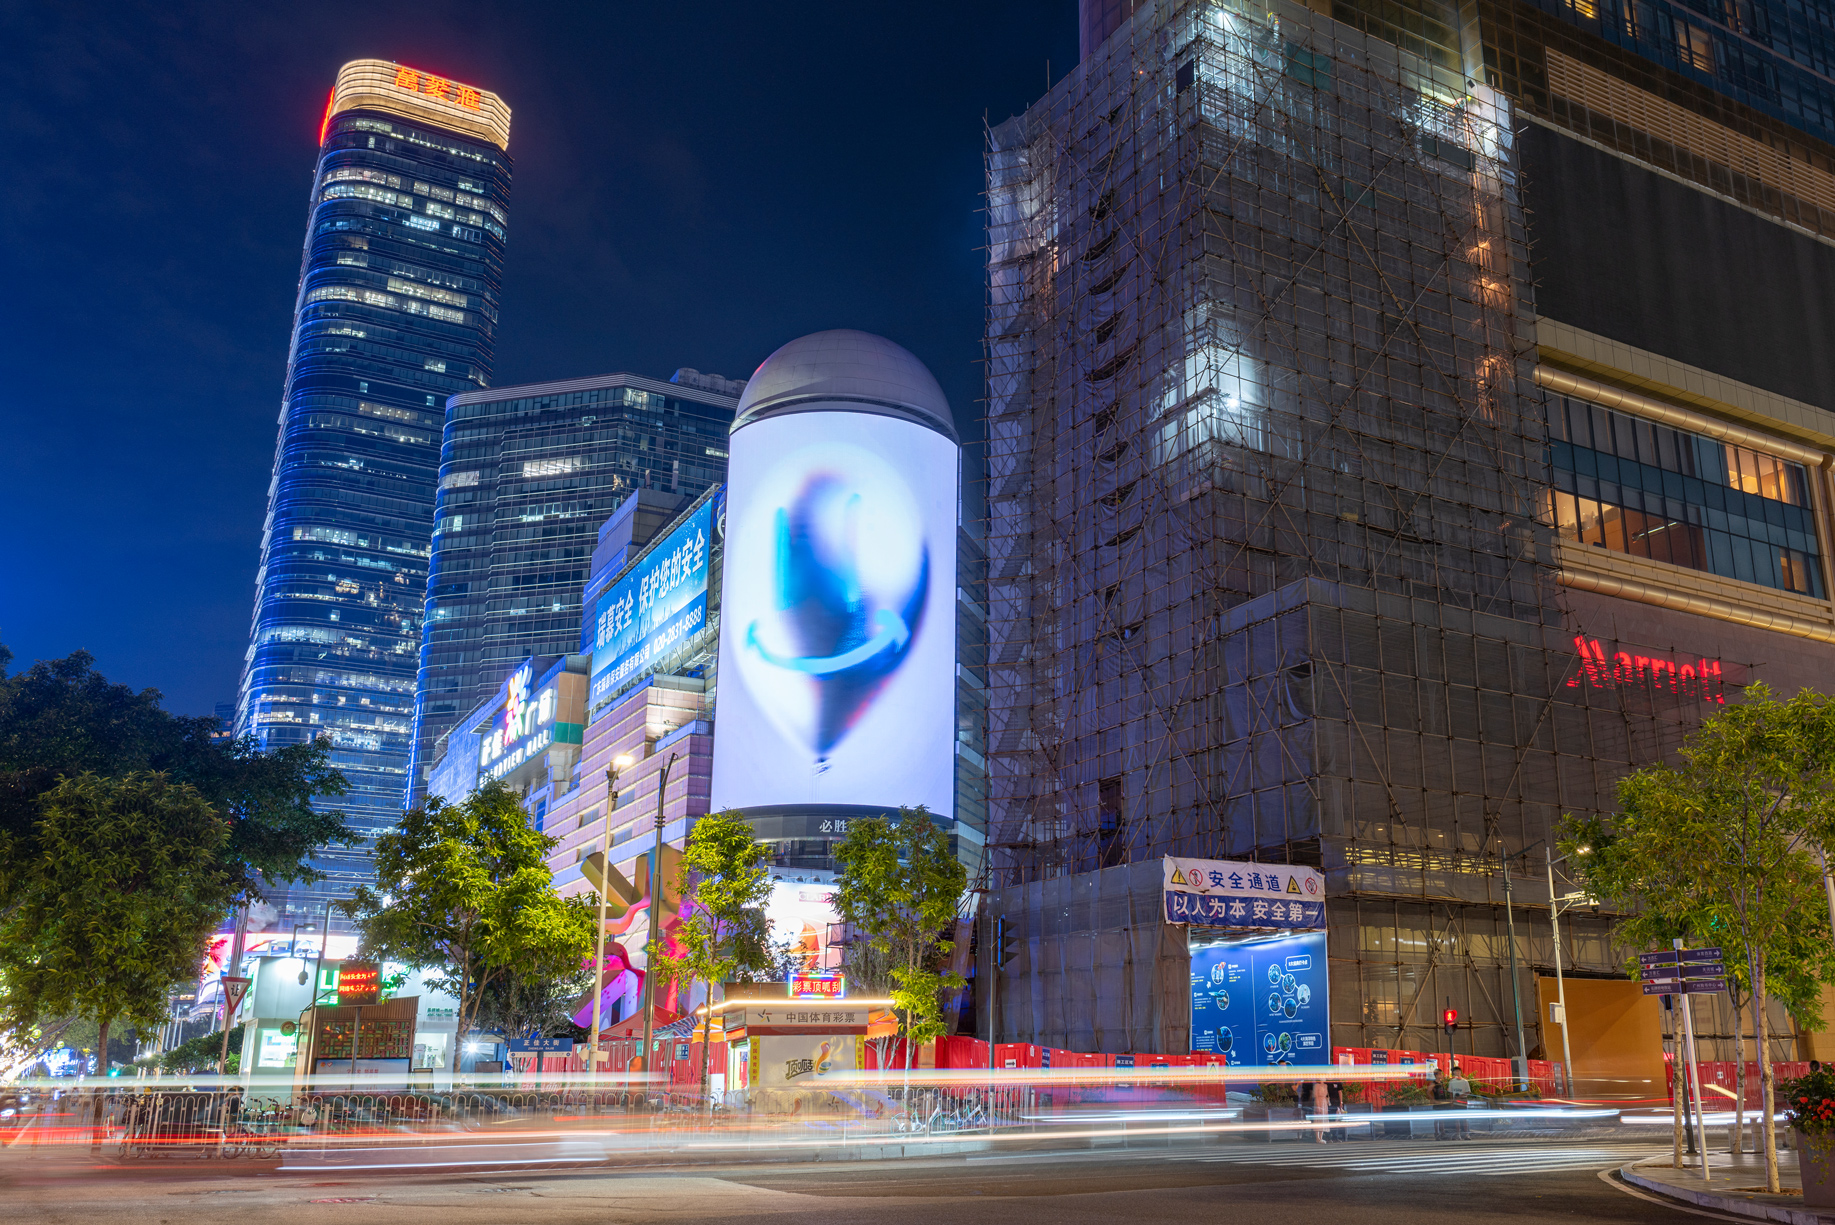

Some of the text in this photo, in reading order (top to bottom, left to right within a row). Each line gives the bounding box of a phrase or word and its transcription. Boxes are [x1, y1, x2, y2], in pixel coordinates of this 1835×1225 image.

[596, 528, 706, 650] 瑞慕安全 保护您的安全
[653, 605, 702, 655] 020-2831-8888
[1566, 635, 1725, 704] Marriott
[819, 819, 848, 833] 必胜
[1208, 869, 1282, 892] 安全通道
[799, 892, 832, 902] CLARI
[1173, 895, 1319, 922] 以人为本 安全第一
[231, 984, 239, 997] 让
[792, 980, 842, 993] 彩票顶呱刮
[786, 1012, 856, 1023] 中国体育彩票
[523, 1039, 560, 1047] 正佳大街
